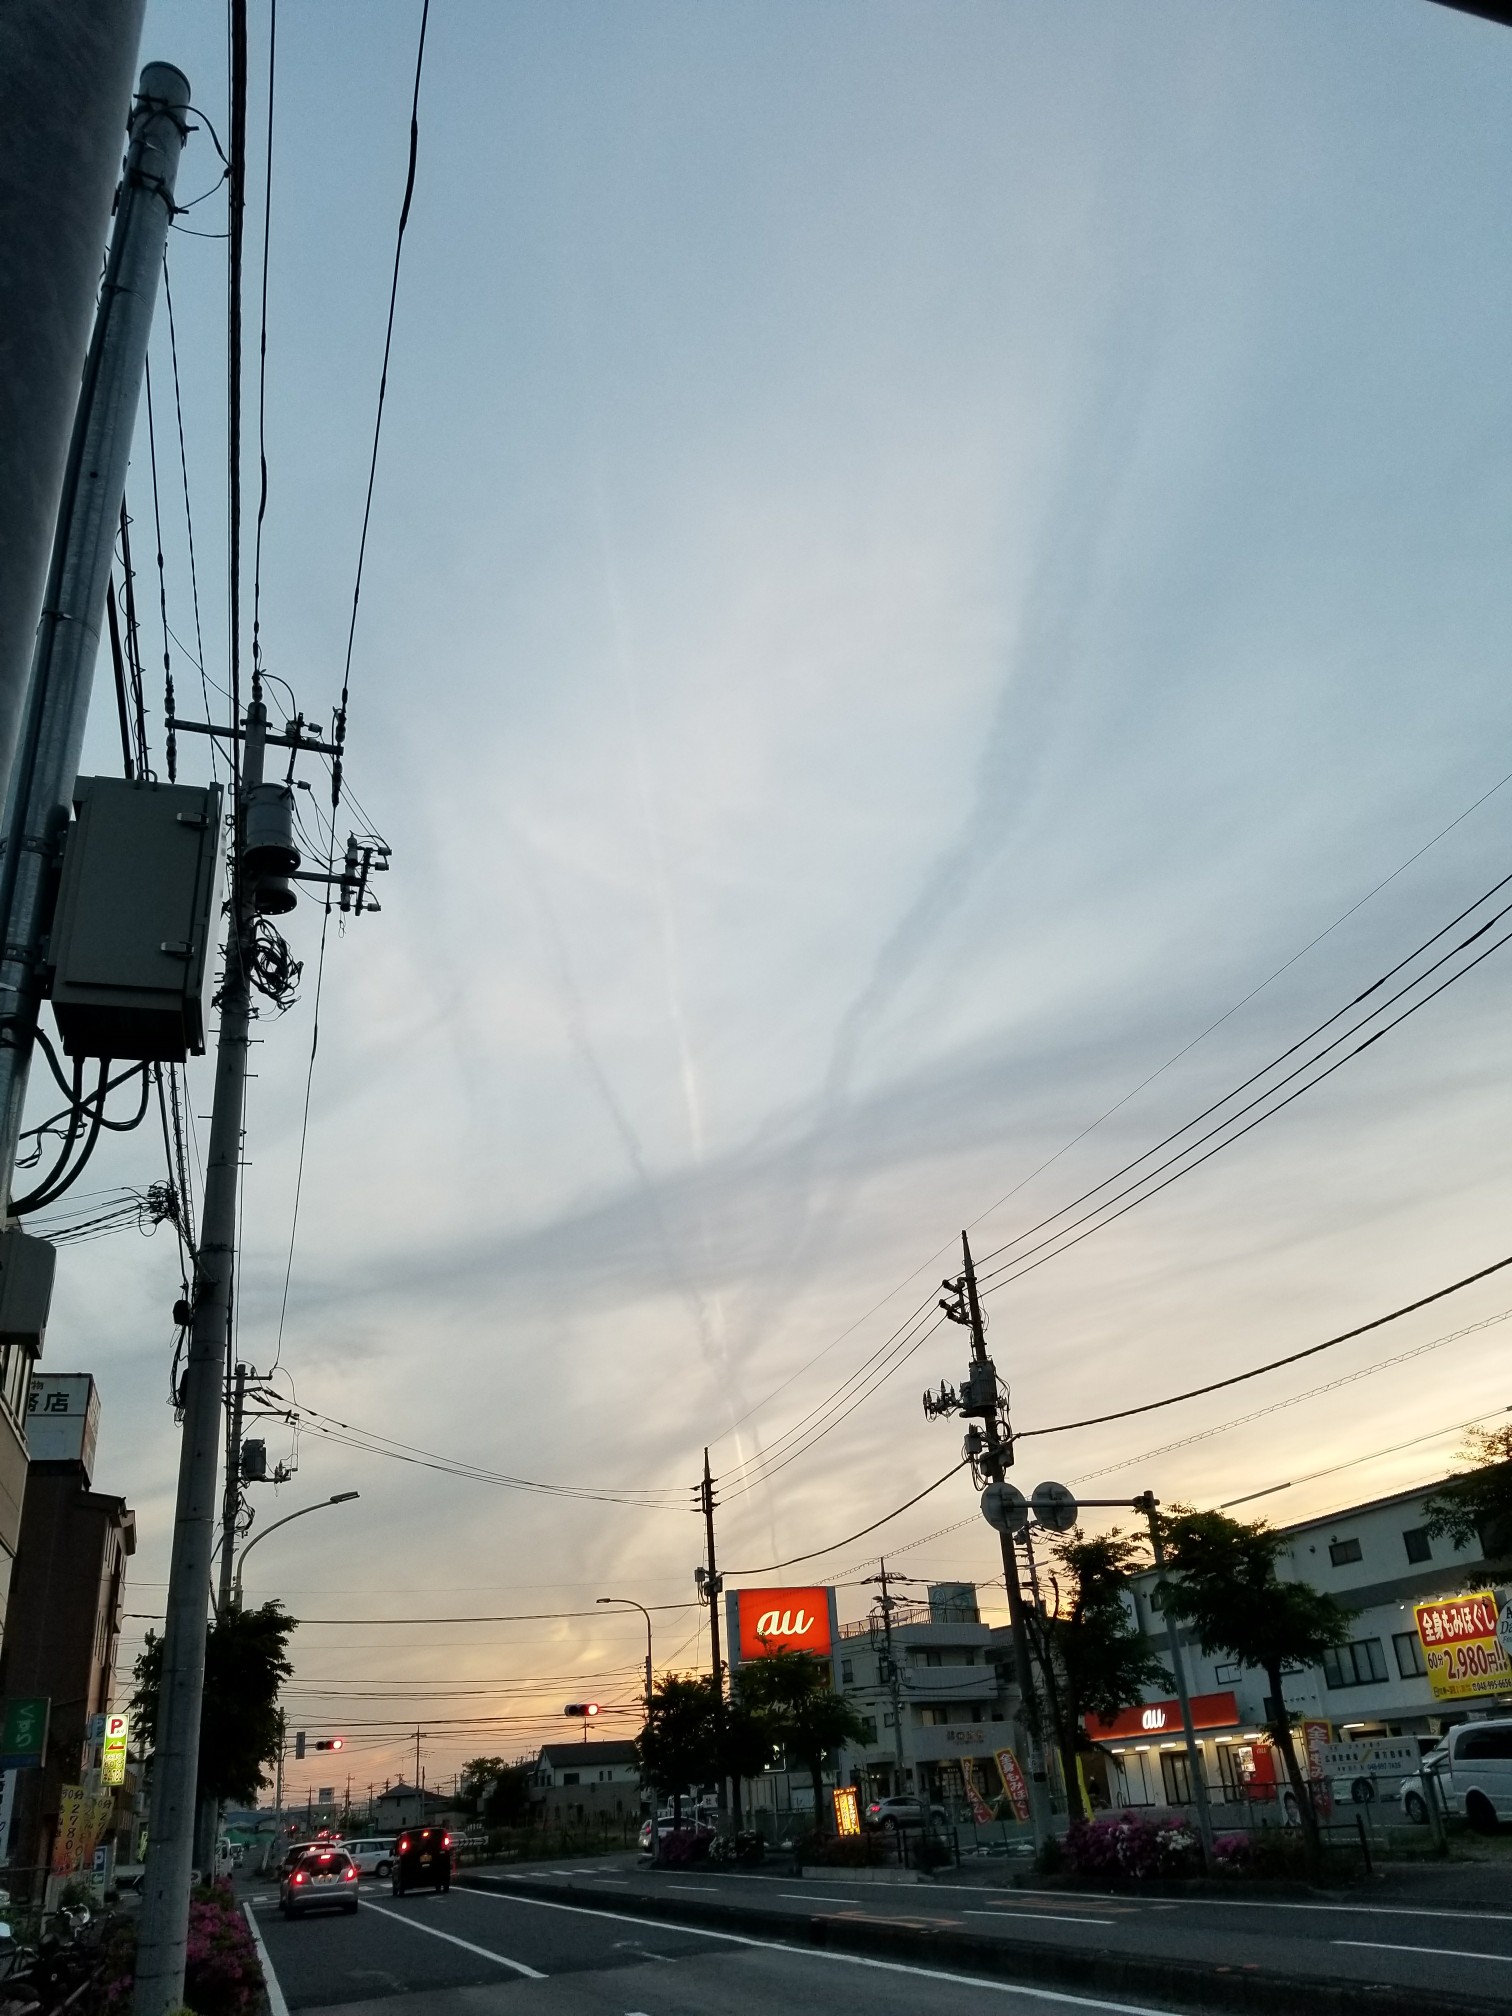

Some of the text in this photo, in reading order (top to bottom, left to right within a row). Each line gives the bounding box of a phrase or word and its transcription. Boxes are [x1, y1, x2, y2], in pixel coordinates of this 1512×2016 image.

[756, 1609, 815, 1637] au
[1422, 1603, 1495, 1642] 全身もみほぐし
[1427, 1651, 1444, 1669] 60分
[110, 1718, 123, 1735] P
[1142, 1708, 1166, 1730] au
[94, 1850, 105, 1872] P
